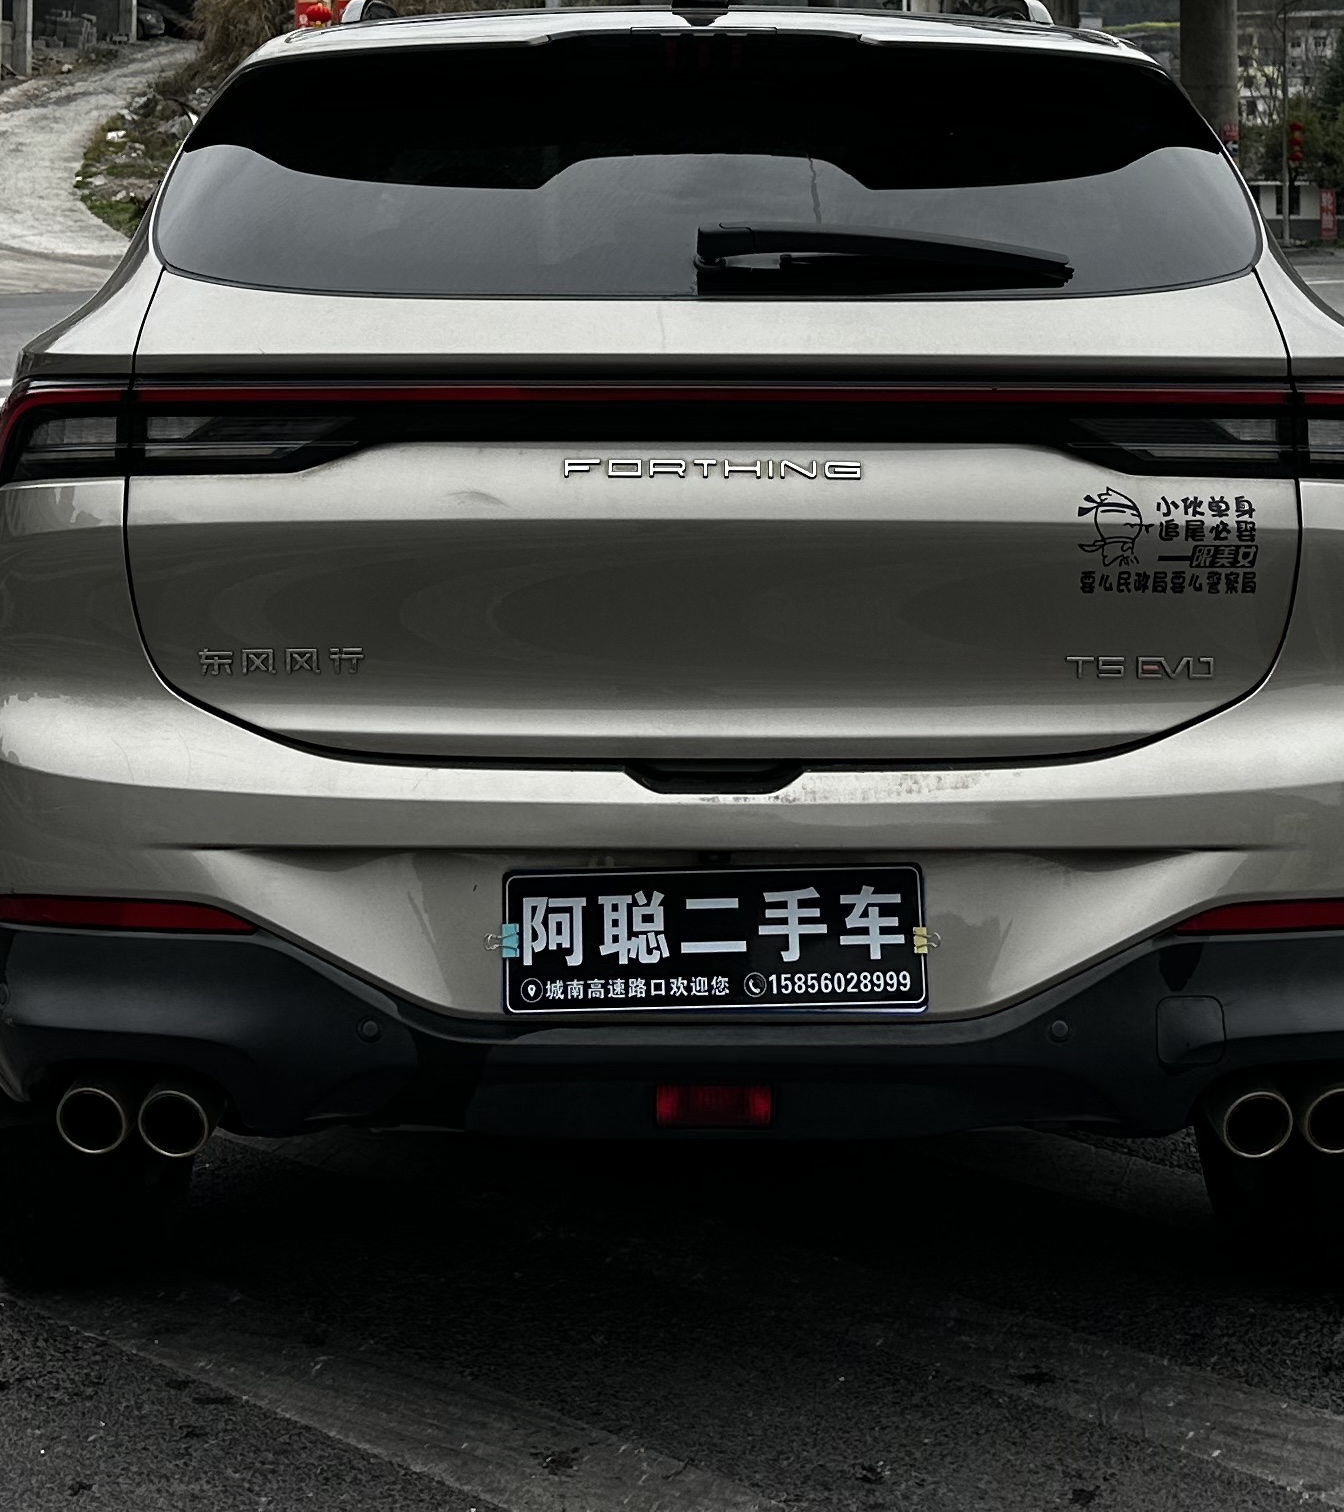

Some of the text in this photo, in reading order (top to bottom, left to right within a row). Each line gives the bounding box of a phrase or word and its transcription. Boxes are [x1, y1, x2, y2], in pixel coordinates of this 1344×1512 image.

[563, 457, 863, 481] FORTHING
[1156, 495, 1256, 519] 小伙单身
[1158, 519, 1257, 543] 追尾必娶
[1080, 570, 1257, 595] 要么民政局要么警察局
[197, 647, 366, 677] 东风风行
[1066, 655, 1126, 680] T5
[522, 885, 907, 967] 阿聪二手车
[544, 970, 912, 1000] 城南高速路口欢迎您 15856028999
